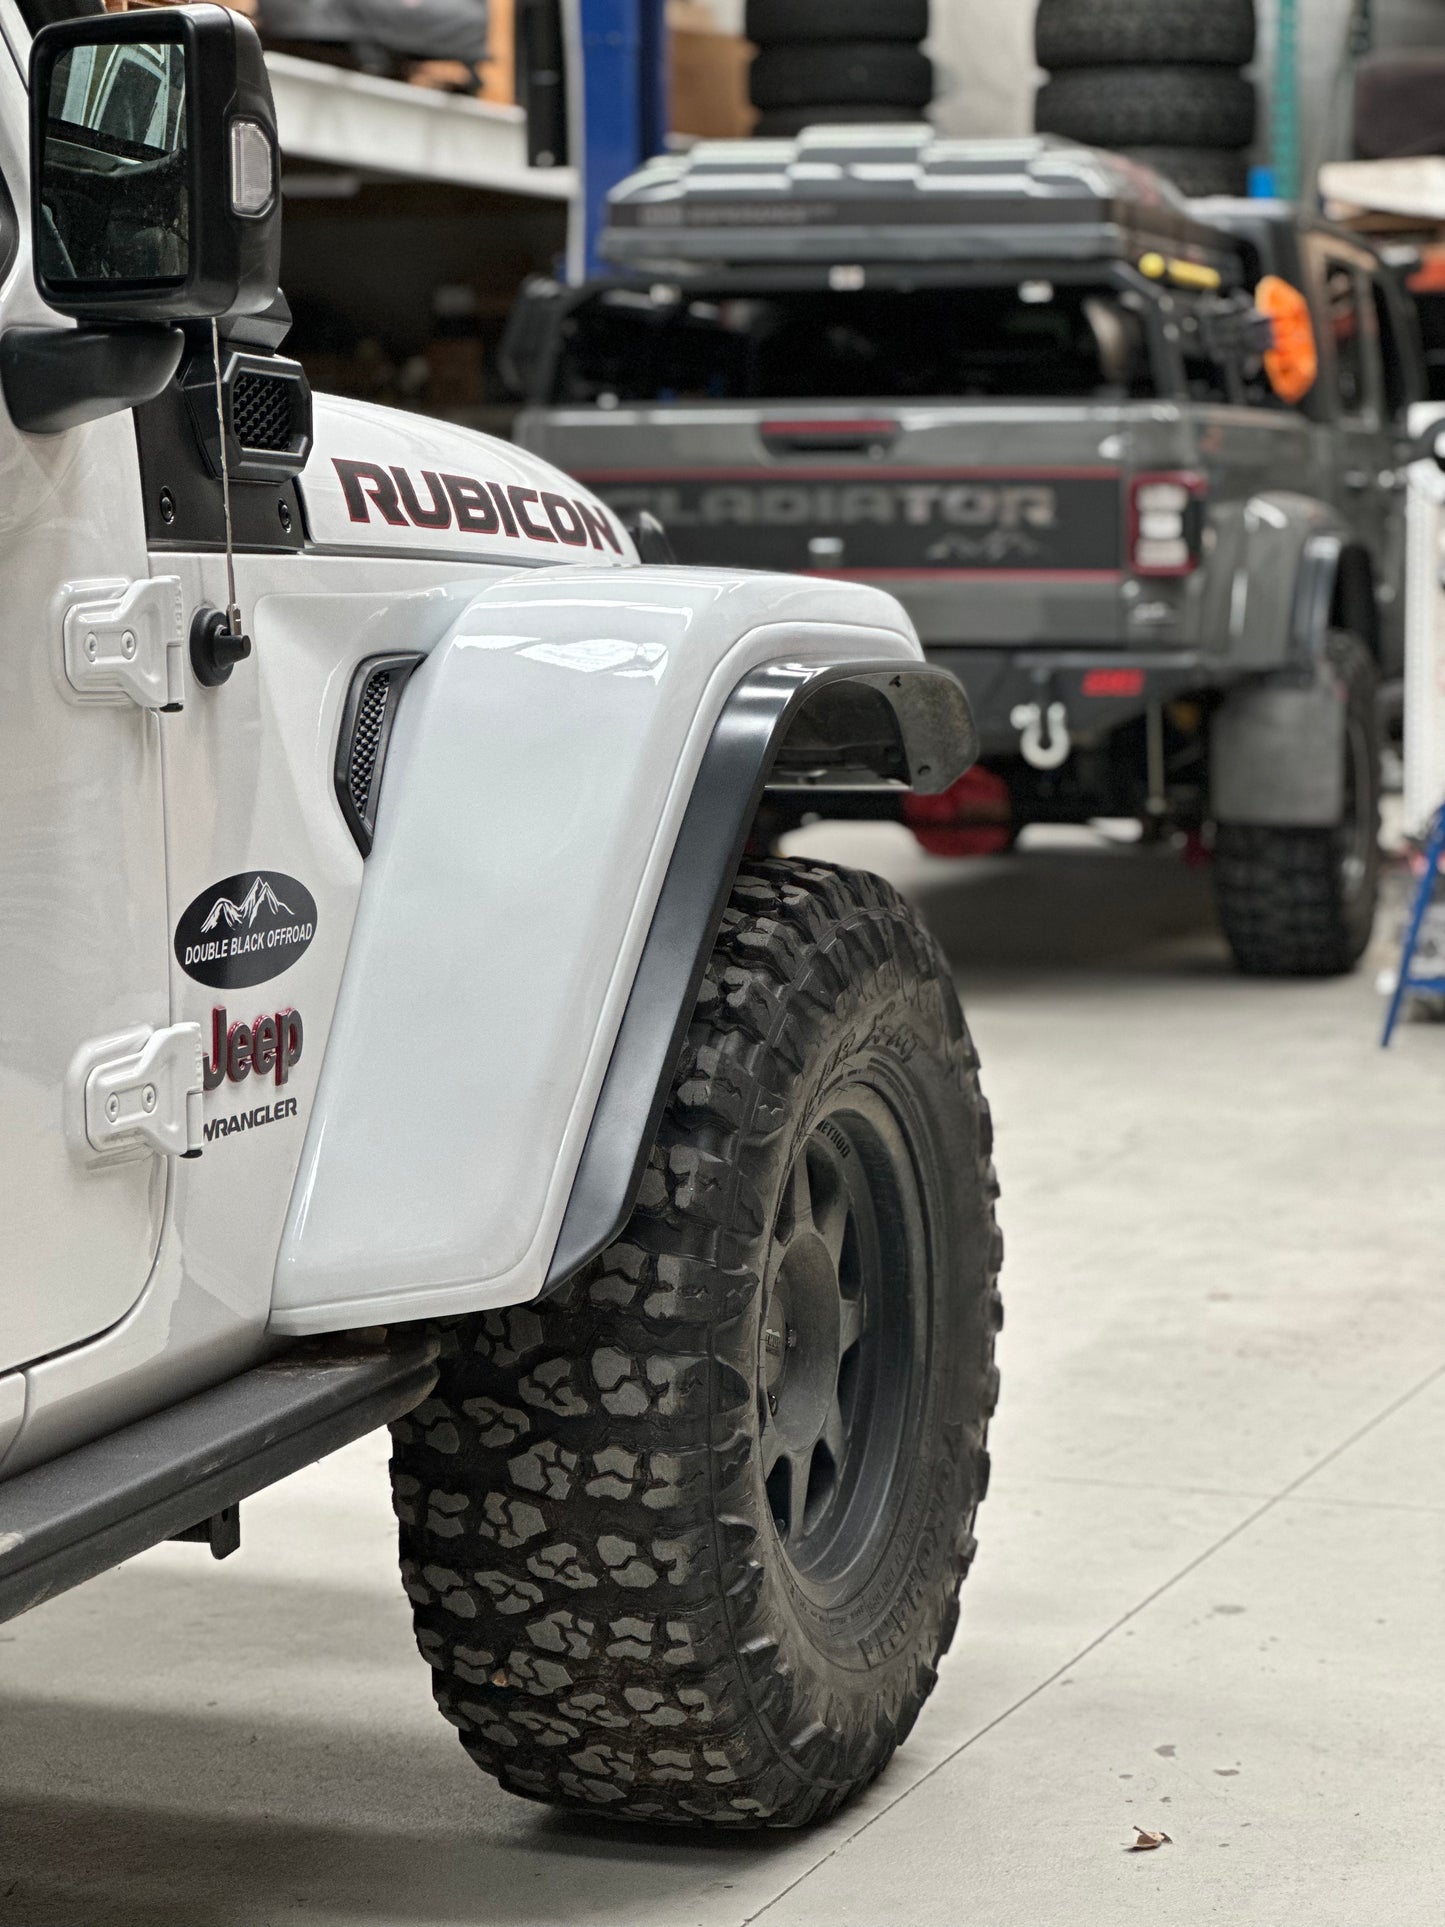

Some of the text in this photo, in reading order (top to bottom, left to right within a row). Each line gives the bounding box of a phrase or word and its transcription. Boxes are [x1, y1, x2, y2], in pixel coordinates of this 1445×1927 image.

[331, 457, 624, 555] RUBICON
[185, 922, 313, 965] DOUBLE BLACK OFFROAD
[202, 1005, 304, 1091] Jeep
